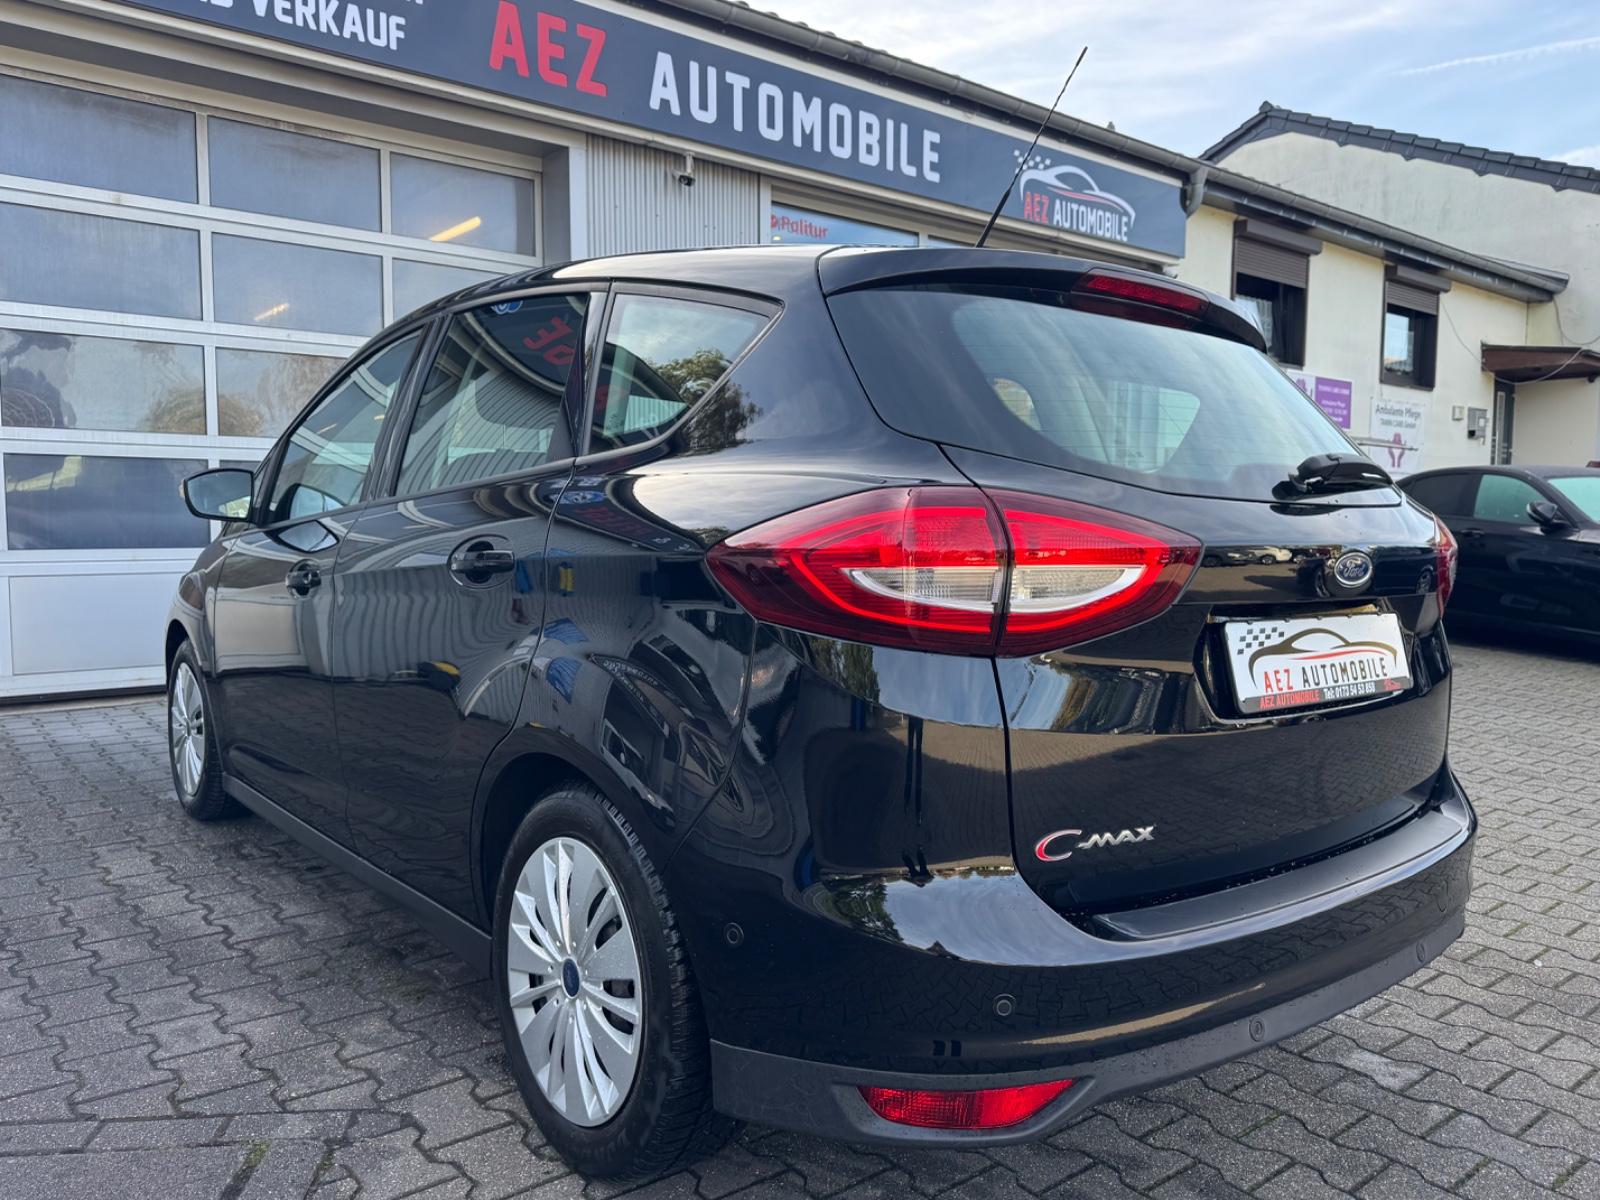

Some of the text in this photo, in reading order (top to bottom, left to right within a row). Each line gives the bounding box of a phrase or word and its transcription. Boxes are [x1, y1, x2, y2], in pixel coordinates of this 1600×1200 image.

[488, 3, 942, 184] AEZ AUTOMOBILE
[1023, 191, 1129, 242] AEZ AUTOMOBILE
[1342, 559, 1367, 578] Ford
[1263, 656, 1388, 693] AEZ AUTOMOBILE
[1259, 695, 1275, 710] AEZ
